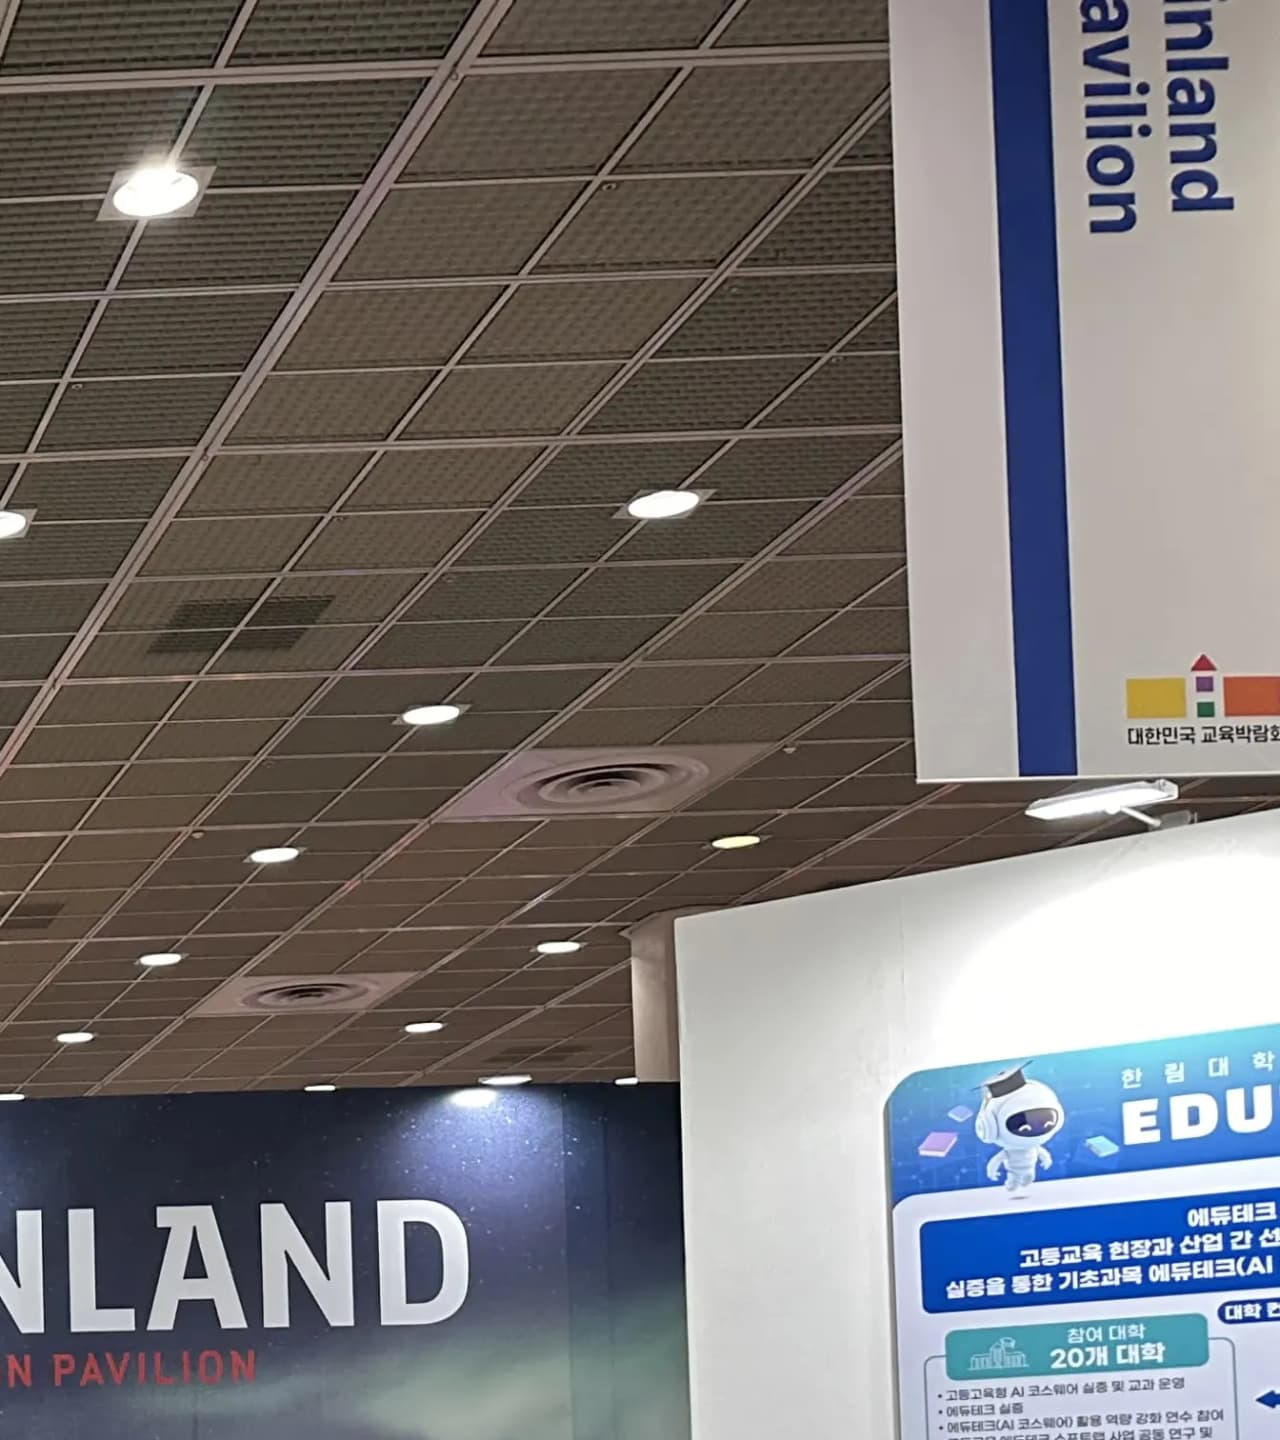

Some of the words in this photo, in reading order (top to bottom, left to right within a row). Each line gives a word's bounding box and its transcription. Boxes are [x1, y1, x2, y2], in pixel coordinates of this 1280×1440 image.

[1079, 0, 1152, 234] avilion
[1162, 0, 1235, 213] nland
[1128, 726, 1196, 745] 대한민국
[1122, 1084, 1280, 1145] EDU
[1187, 1201, 1277, 1227] 에듀테크
[1019, 1243, 1103, 1268] 고등교육
[1109, 1236, 1174, 1261] 현장과
[1180, 1233, 1223, 1255] 산업
[1230, 1230, 1253, 1250] 간
[946, 1277, 1006, 1299] 실증을
[1011, 1273, 1053, 1294] 통한
[1058, 1265, 1142, 1289] 기초과목
[1148, 1255, 1273, 1283] 에듀테크(AI
[1224, 1304, 1262, 1321] 대학
[1067, 1326, 1103, 1344] 참여
[1109, 1323, 1146, 1340] 대학
[54, 1348, 257, 1388] PAVILION
[1050, 1345, 1108, 1369] 20개
[1116, 1343, 1165, 1365] 대학
[1011, 1386, 1025, 1398] AI
[1128, 1378, 1155, 1391] 교과
[946, 1404, 996, 1417] 에듀테크
[1165, 1410, 1193, 1423] 연수
[1168, 1427, 1196, 1440] 연구
